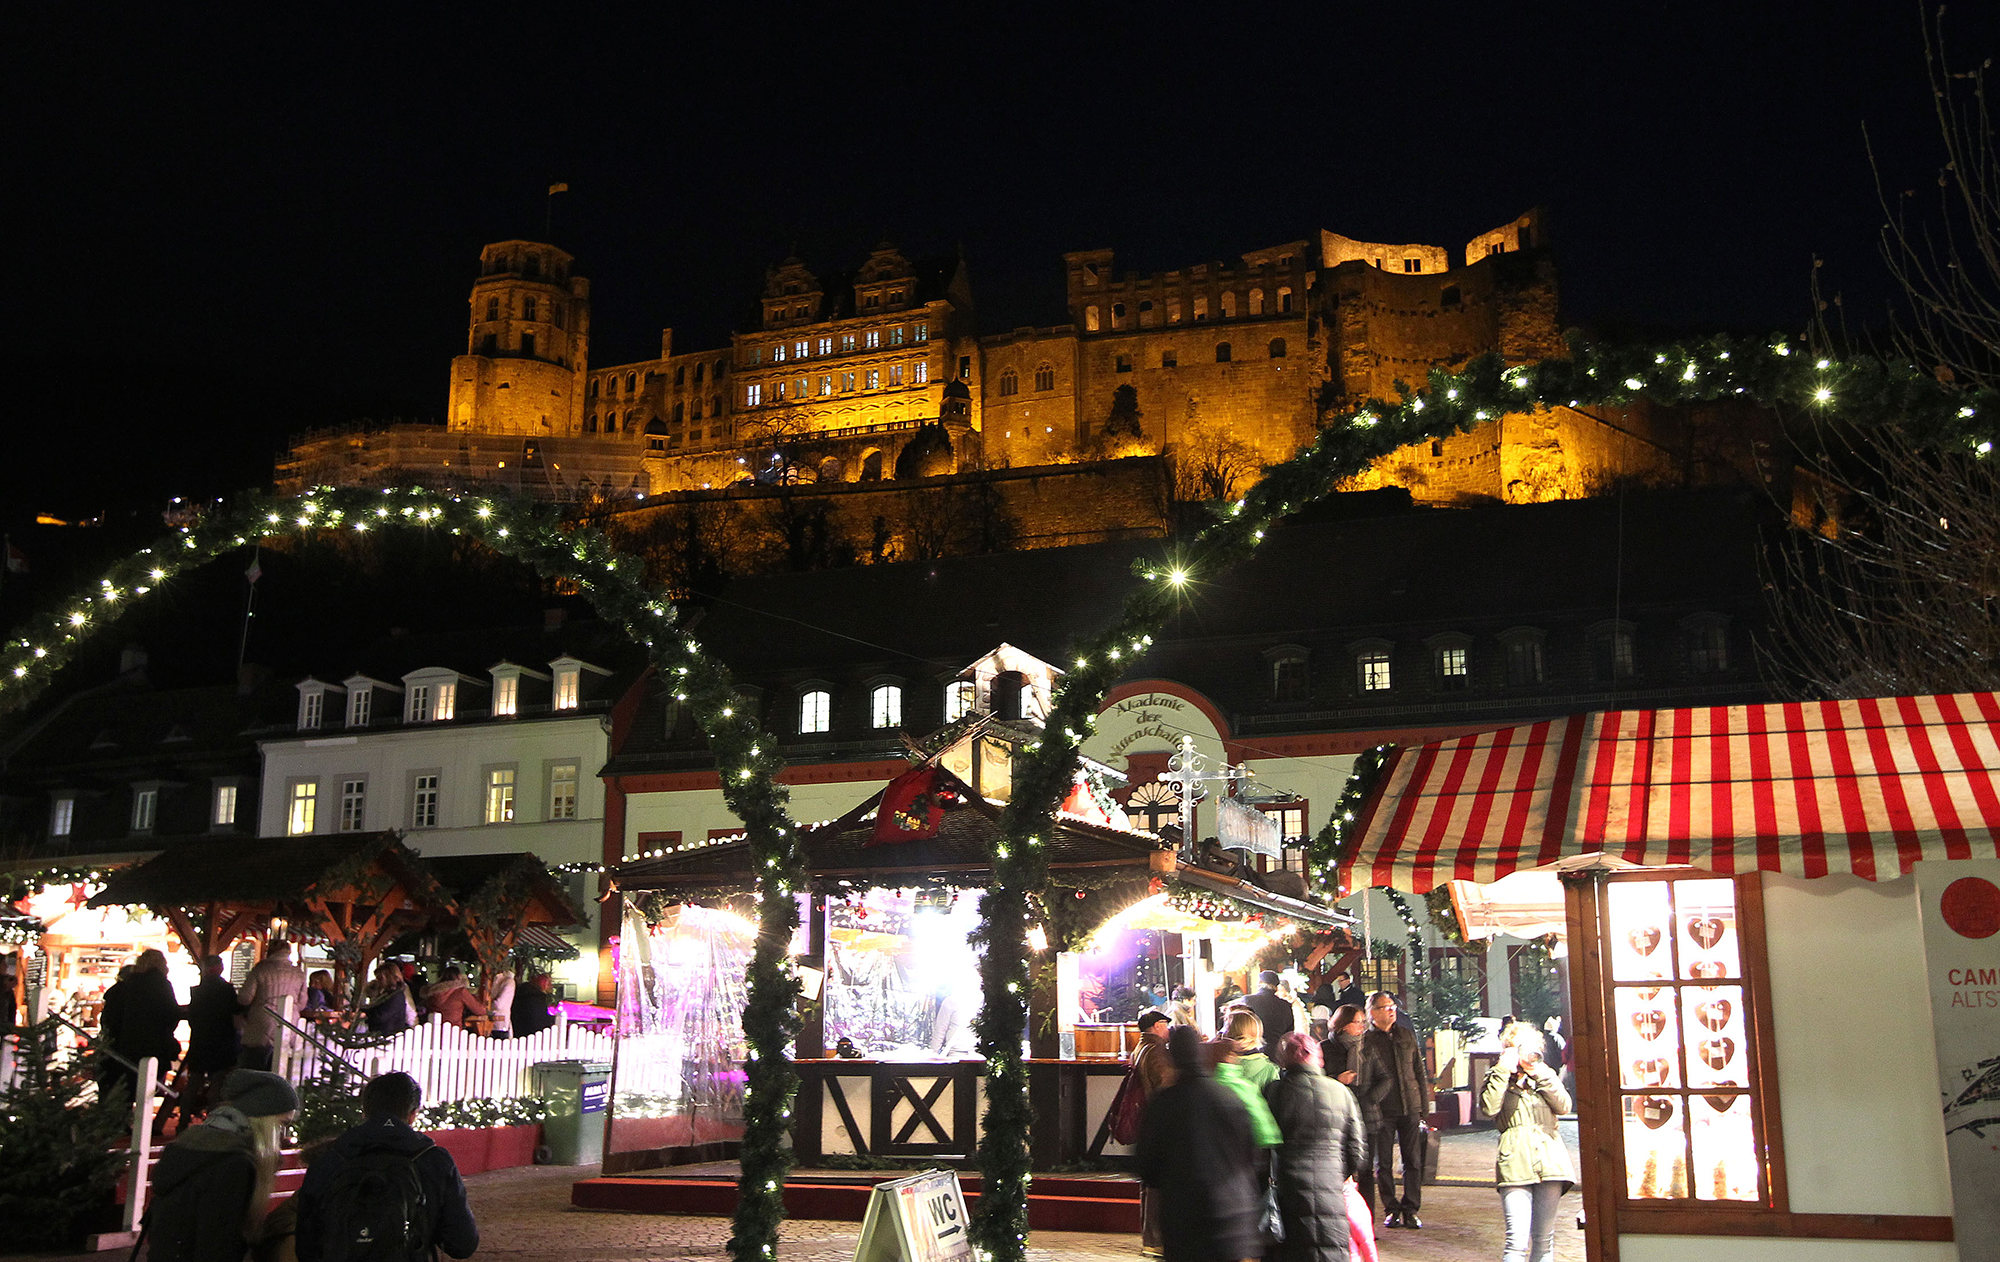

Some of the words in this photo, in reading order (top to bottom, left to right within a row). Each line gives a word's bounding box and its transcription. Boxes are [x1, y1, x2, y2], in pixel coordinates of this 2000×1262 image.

[1117, 693, 1185, 717] Akademie
[1136, 710, 1162, 724] der
[1106, 725, 1185, 764] Wissenschafte
[1948, 968, 2000, 986] CAM
[927, 1193, 957, 1226] WC
